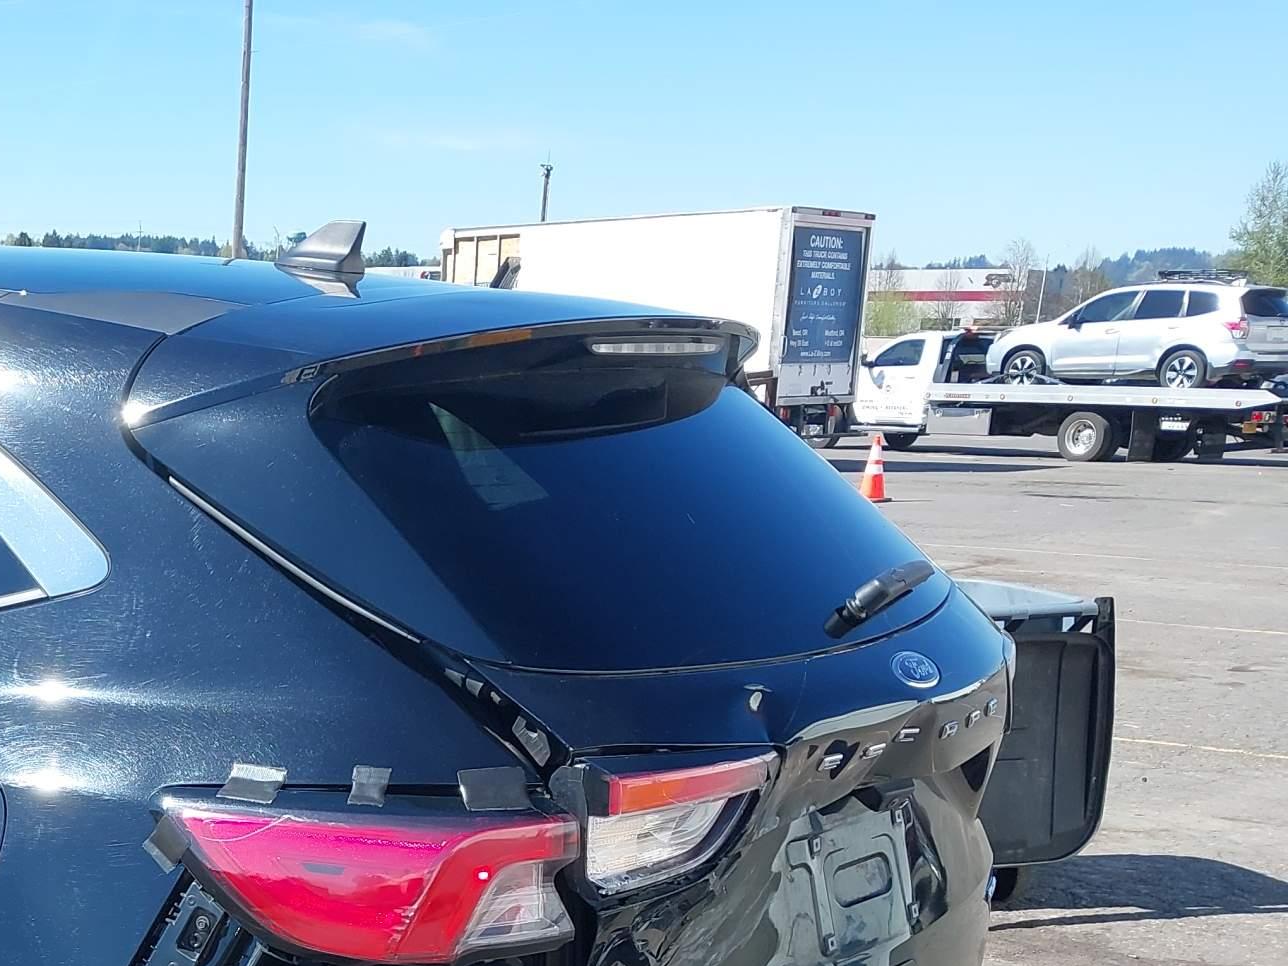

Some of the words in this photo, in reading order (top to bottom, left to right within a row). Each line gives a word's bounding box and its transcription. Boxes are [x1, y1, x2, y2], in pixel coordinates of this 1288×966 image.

[810, 235, 843, 249] CAUTION:
[813, 250, 827, 258] TRUCK
[797, 260, 821, 269] EXTREMELY
[822, 261, 851, 270] COMFORTABLE
[818, 698, 999, 771] ESCAPE
